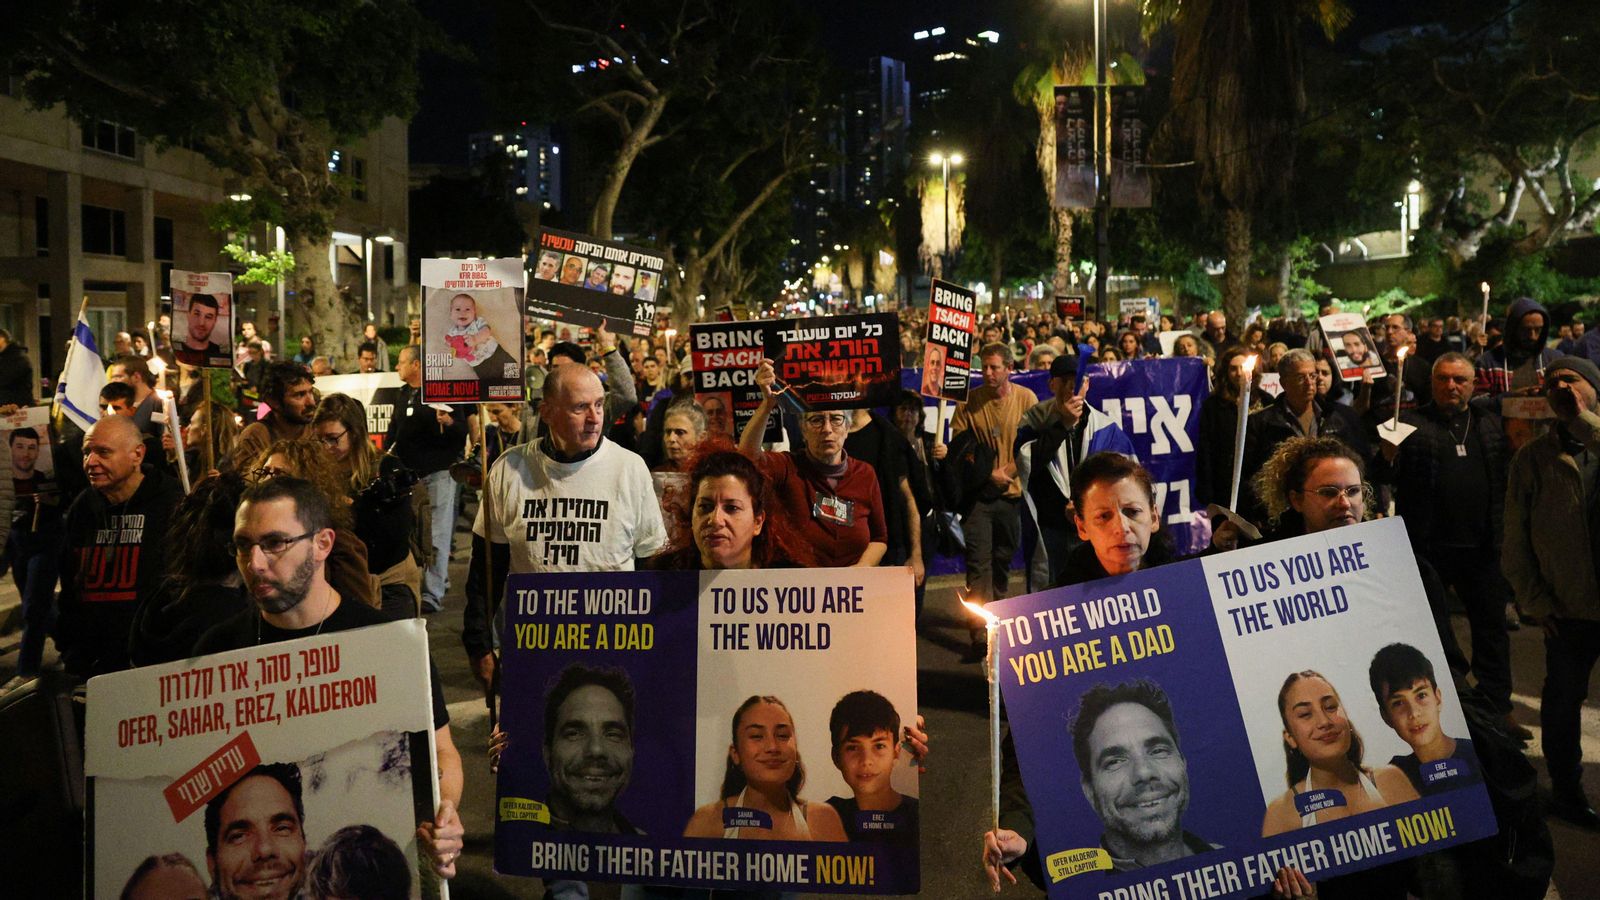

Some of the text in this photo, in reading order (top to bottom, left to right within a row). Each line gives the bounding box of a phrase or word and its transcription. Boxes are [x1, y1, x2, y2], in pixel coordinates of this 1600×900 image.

[541, 232, 664, 270] מחזירים אותם הביתה עכשיו!
[934, 286, 972, 312] BRING
[936, 306, 970, 329] TSACHI
[776, 322, 882, 342] כל יום שעובר
[932, 324, 970, 348] BACK!
[426, 353, 453, 367] BRING
[702, 350, 764, 368] TSACH
[785, 338, 879, 360] הורג את
[426, 368, 444, 380] HIM
[783, 356, 883, 379] החטופים
[426, 380, 480, 396] HOME NOW!
[522, 498, 609, 520] תחזירו את
[120, 529, 144, 544] אותם
[526, 521, 602, 542] החטופים
[544, 542, 580, 566] מיד!
[1217, 541, 1369, 600] TO US YOU ARE
[516, 588, 652, 616] TO THE WORLD
[710, 586, 864, 615] TO US YOU ARE
[1227, 585, 1348, 637] THE WORLD
[1000, 588, 1161, 649] TO THE WORLD
[515, 624, 654, 651] YOU ARE A DAD
[710, 623, 832, 650] THE WORLD
[1008, 624, 1175, 686] YOU ARE A DAD
[159, 644, 340, 708] עופר, סהר, ארז קלדרון
[118, 675, 378, 748] OFER, SAHAR, EREZ, KALDERON
[177, 745, 246, 805] עדיין שבוי
[1434, 762, 1447, 772] EREZ
[1434, 771, 1448, 780] HOME
[1447, 768, 1458, 776] NOW
[1304, 799, 1335, 812] IS HOME NOW
[1309, 792, 1326, 802] SAHAR
[532, 841, 876, 887] BRING THEIR FATHER HOME NOW!
[1052, 850, 1099, 868] OFER KALDERON
[1172, 861, 1242, 900] THEIR
[1331, 821, 1397, 868] HOME
[1395, 806, 1458, 849] NOW!
[1058, 860, 1098, 877] STILL CAPTIVE
